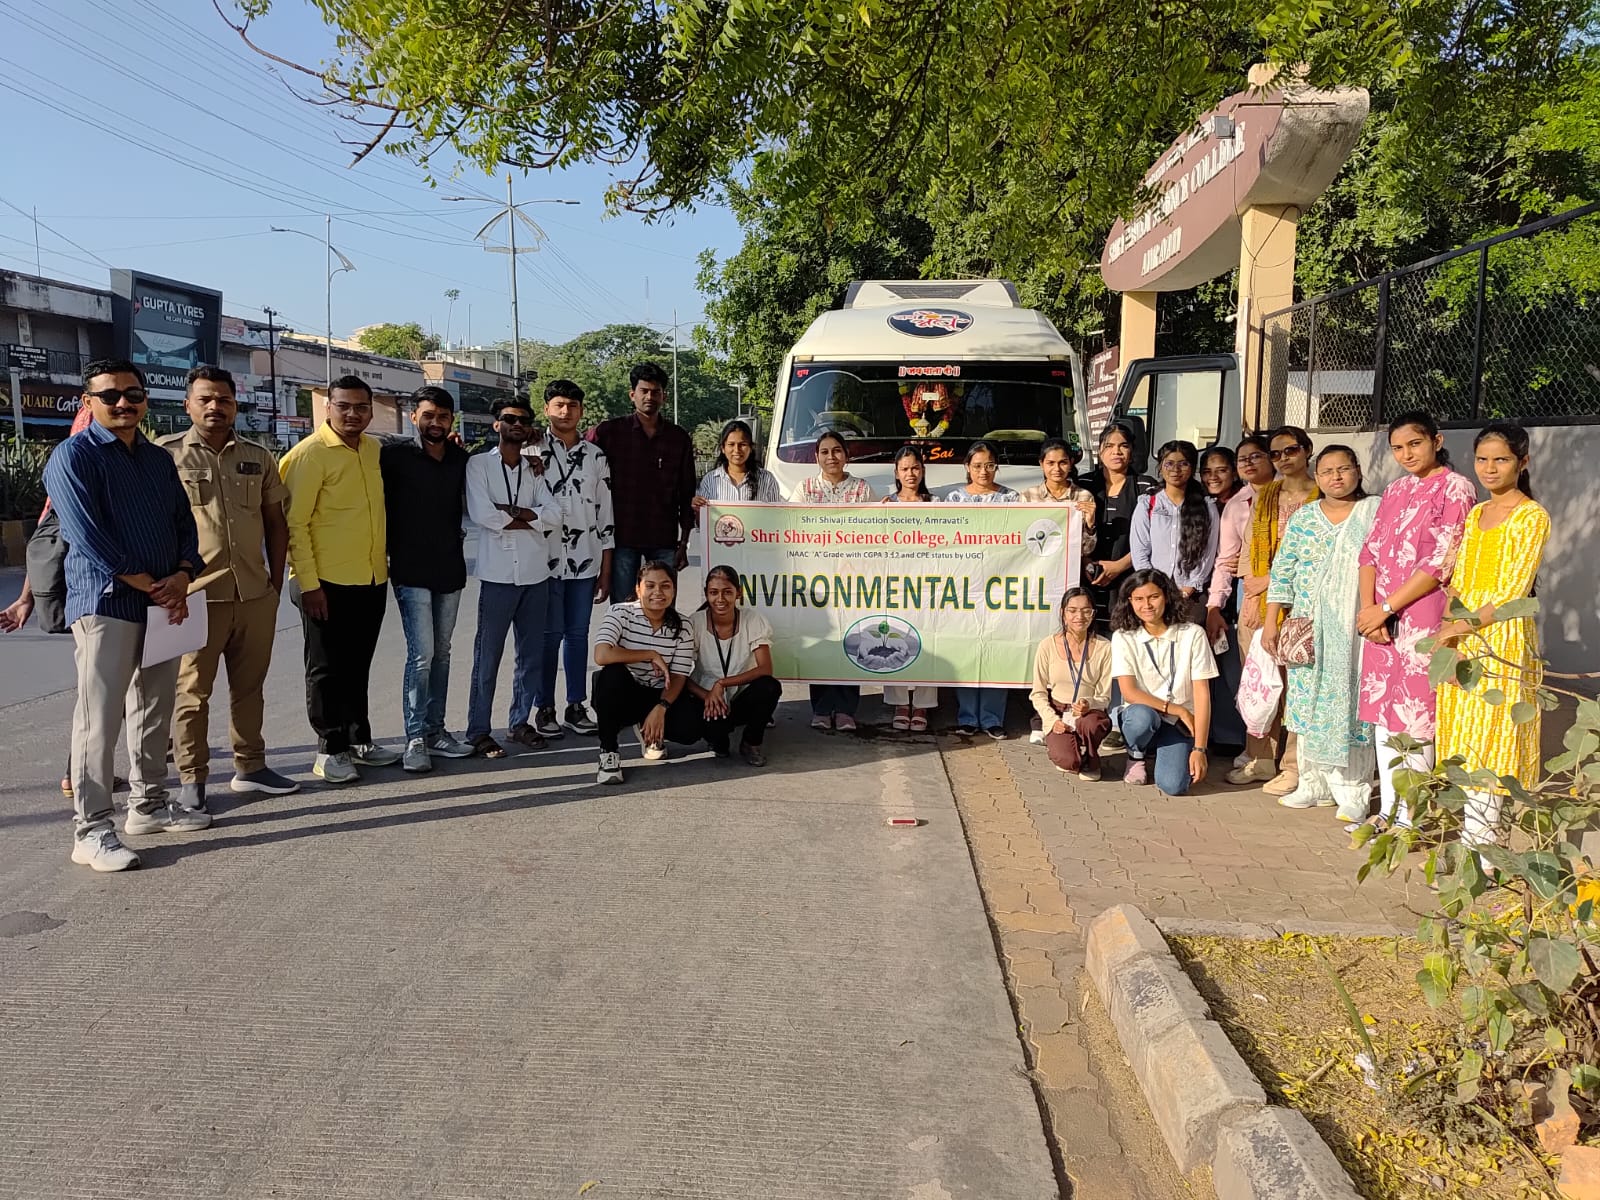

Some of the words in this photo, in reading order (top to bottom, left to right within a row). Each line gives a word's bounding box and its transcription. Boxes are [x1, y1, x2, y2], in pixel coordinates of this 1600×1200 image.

[142, 296, 175, 314] GUPTA
[175, 303, 205, 319] TYRES
[929, 447, 955, 461] Sai
[801, 516, 817, 524] Shri
[819, 516, 846, 526] Shivaji
[848, 516, 888, 525] Education
[890, 517, 922, 526] Society,
[925, 517, 969, 525] Amravati's
[751, 529, 780, 544] Shri
[784, 529, 831, 548] Shivaji
[835, 530, 890, 545] Science
[893, 530, 949, 549] College,
[952, 531, 1022, 545] Amravati
[786, 551, 808, 559] (NAAC
[823, 551, 844, 559] Grade
[845, 551, 862, 559] with
[863, 551, 882, 559] CGPA
[931, 552, 953, 560] status
[954, 552, 964, 561] by
[965, 552, 984, 561] UGC)
[739, 573, 976, 611] NVIRONMENTAL
[984, 575, 1052, 611] CELL
